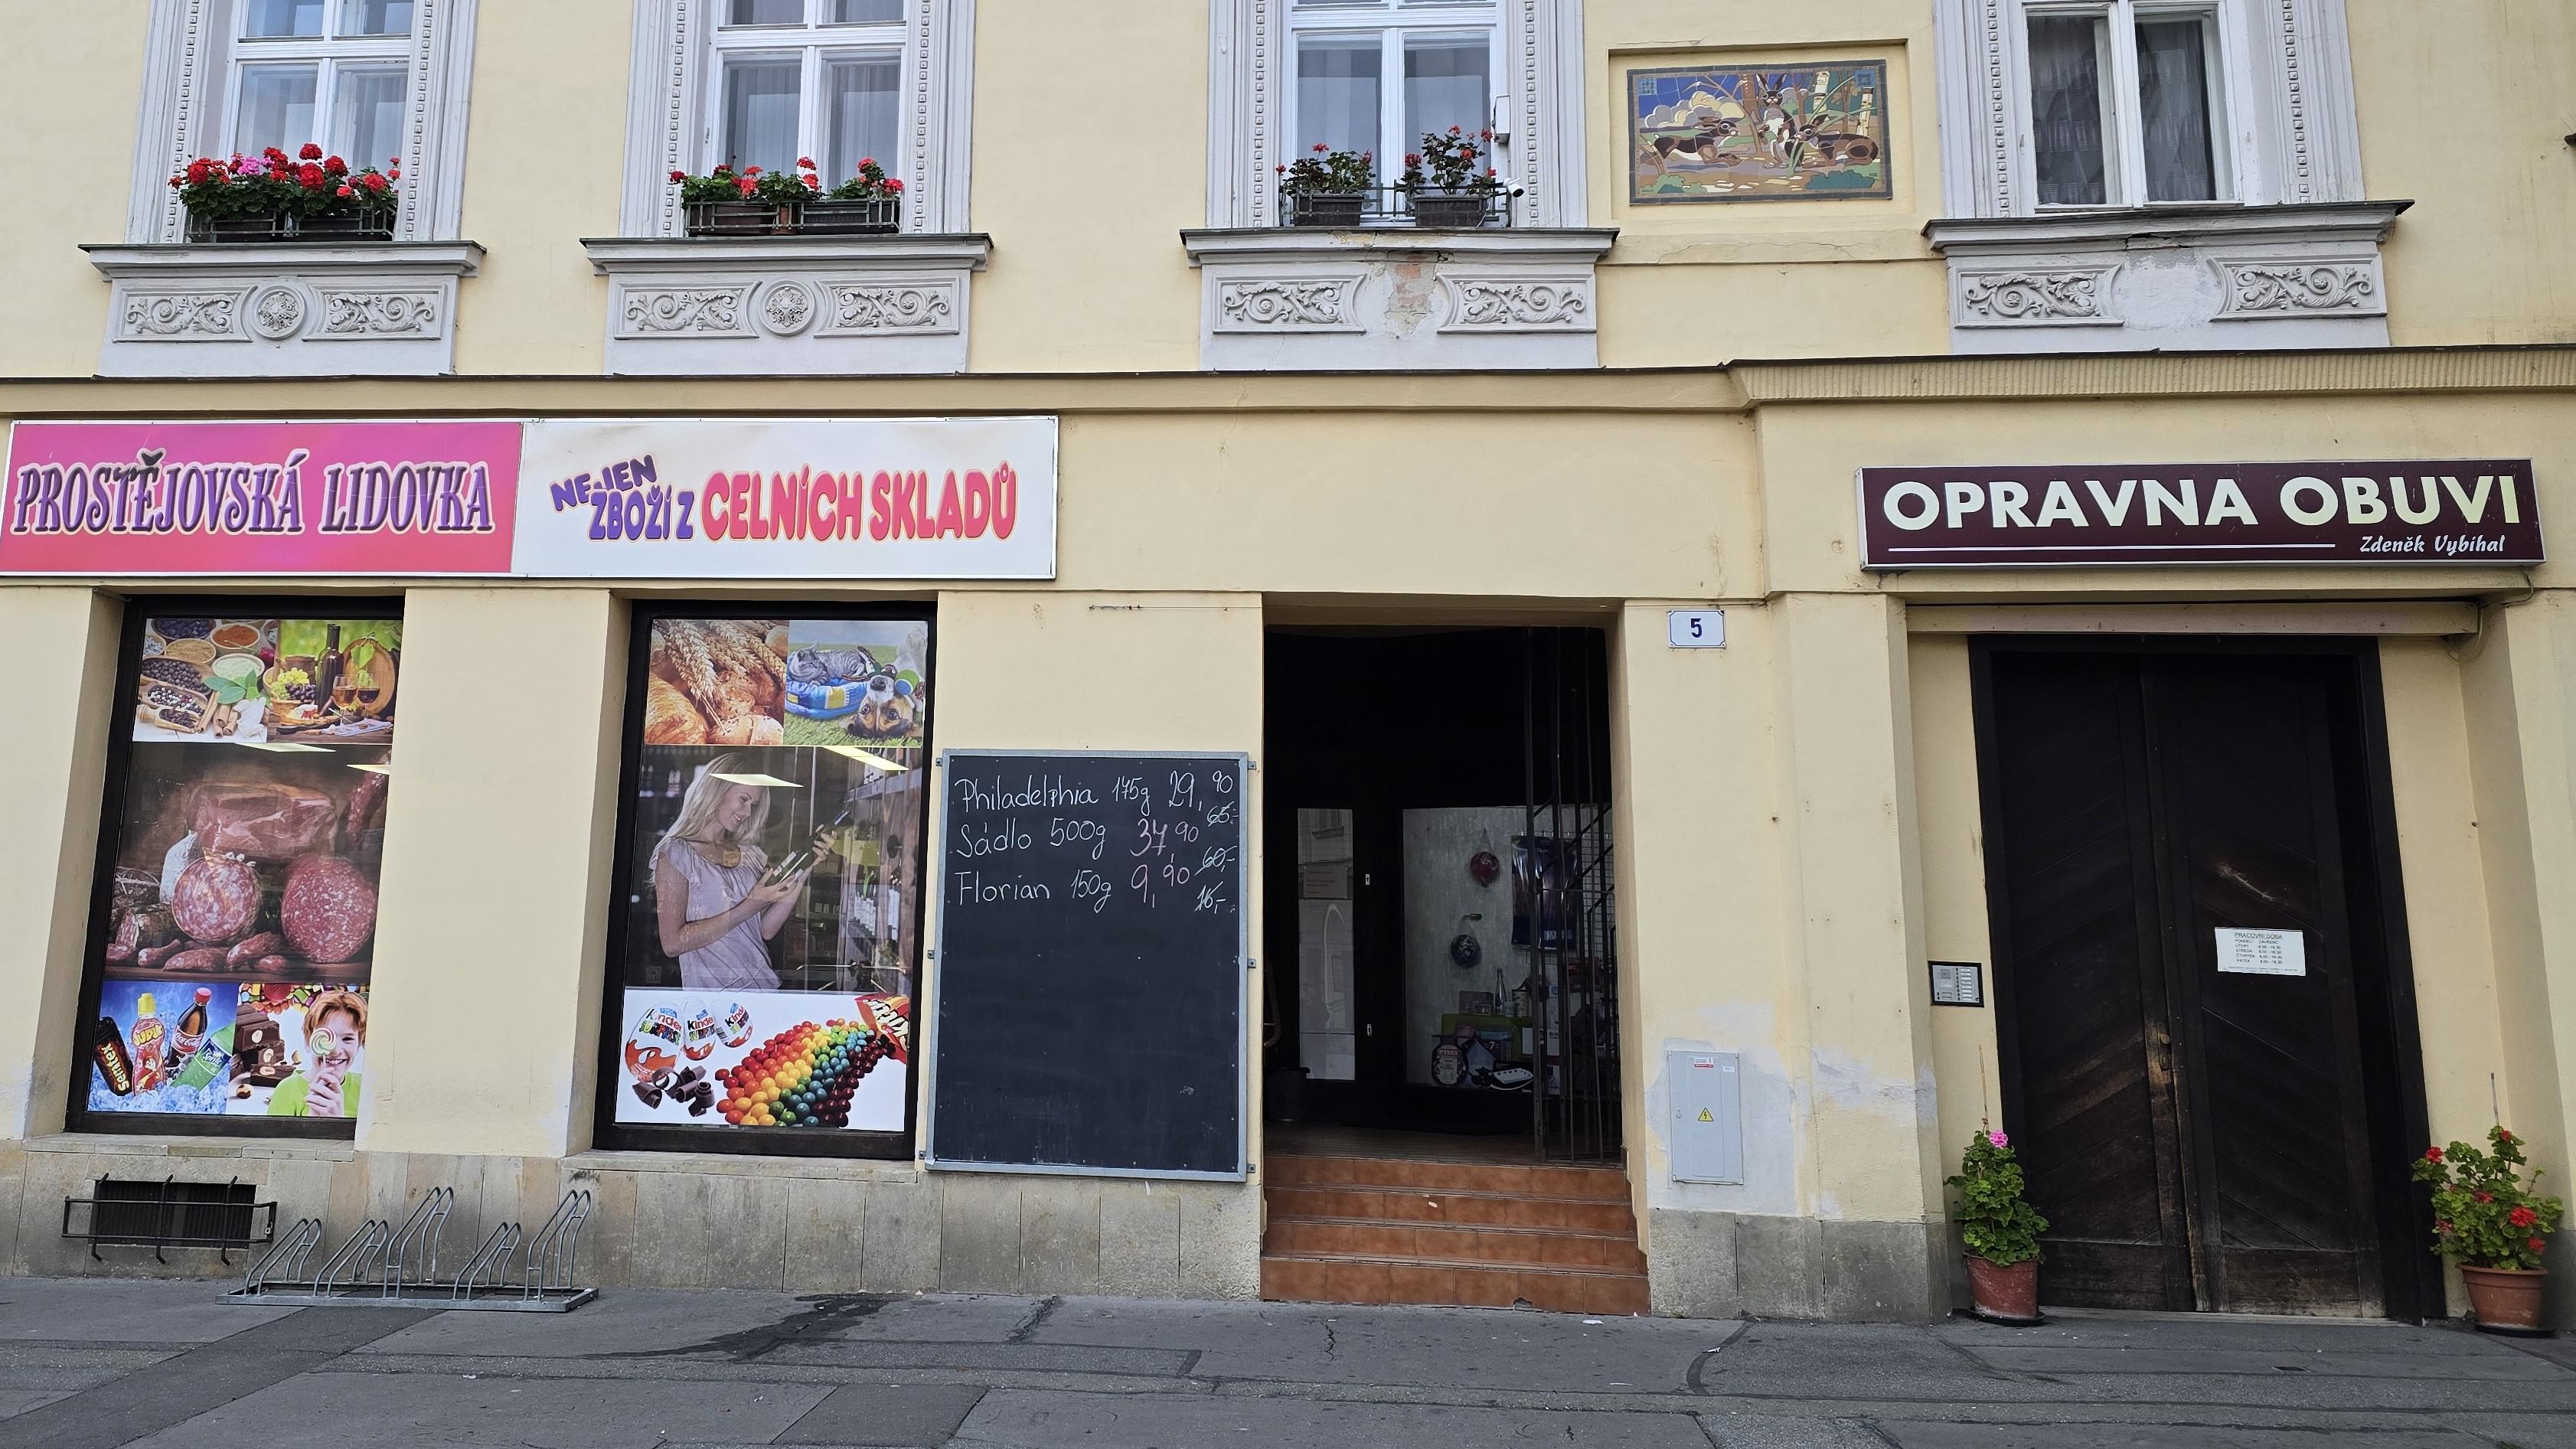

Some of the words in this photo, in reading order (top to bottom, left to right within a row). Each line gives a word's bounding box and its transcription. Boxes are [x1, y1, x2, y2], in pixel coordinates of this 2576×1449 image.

[11, 449, 308, 533] PROSTĚJOVSKÁ
[320, 463, 494, 533] LIDOVKA
[589, 484, 672, 540] ZBOŽÍ
[676, 490, 694, 540] Z
[702, 465, 863, 540] CELNÍCH
[869, 462, 1017, 540] SKLADŮ
[1882, 478, 2259, 530] OPRAVNA
[2280, 475, 2520, 526] OBUVI
[2360, 534, 2425, 553] Zdeněk
[2434, 534, 2506, 556] Vybíhal
[1690, 618, 1703, 638] 5
[955, 774, 1099, 812] Philadelphia
[1112, 775, 1150, 816] 175g
[957, 818, 1032, 857] Sádlo
[1050, 818, 1106, 860] 500g
[955, 871, 1050, 906] Florian
[1071, 869, 1111, 913] 150g
